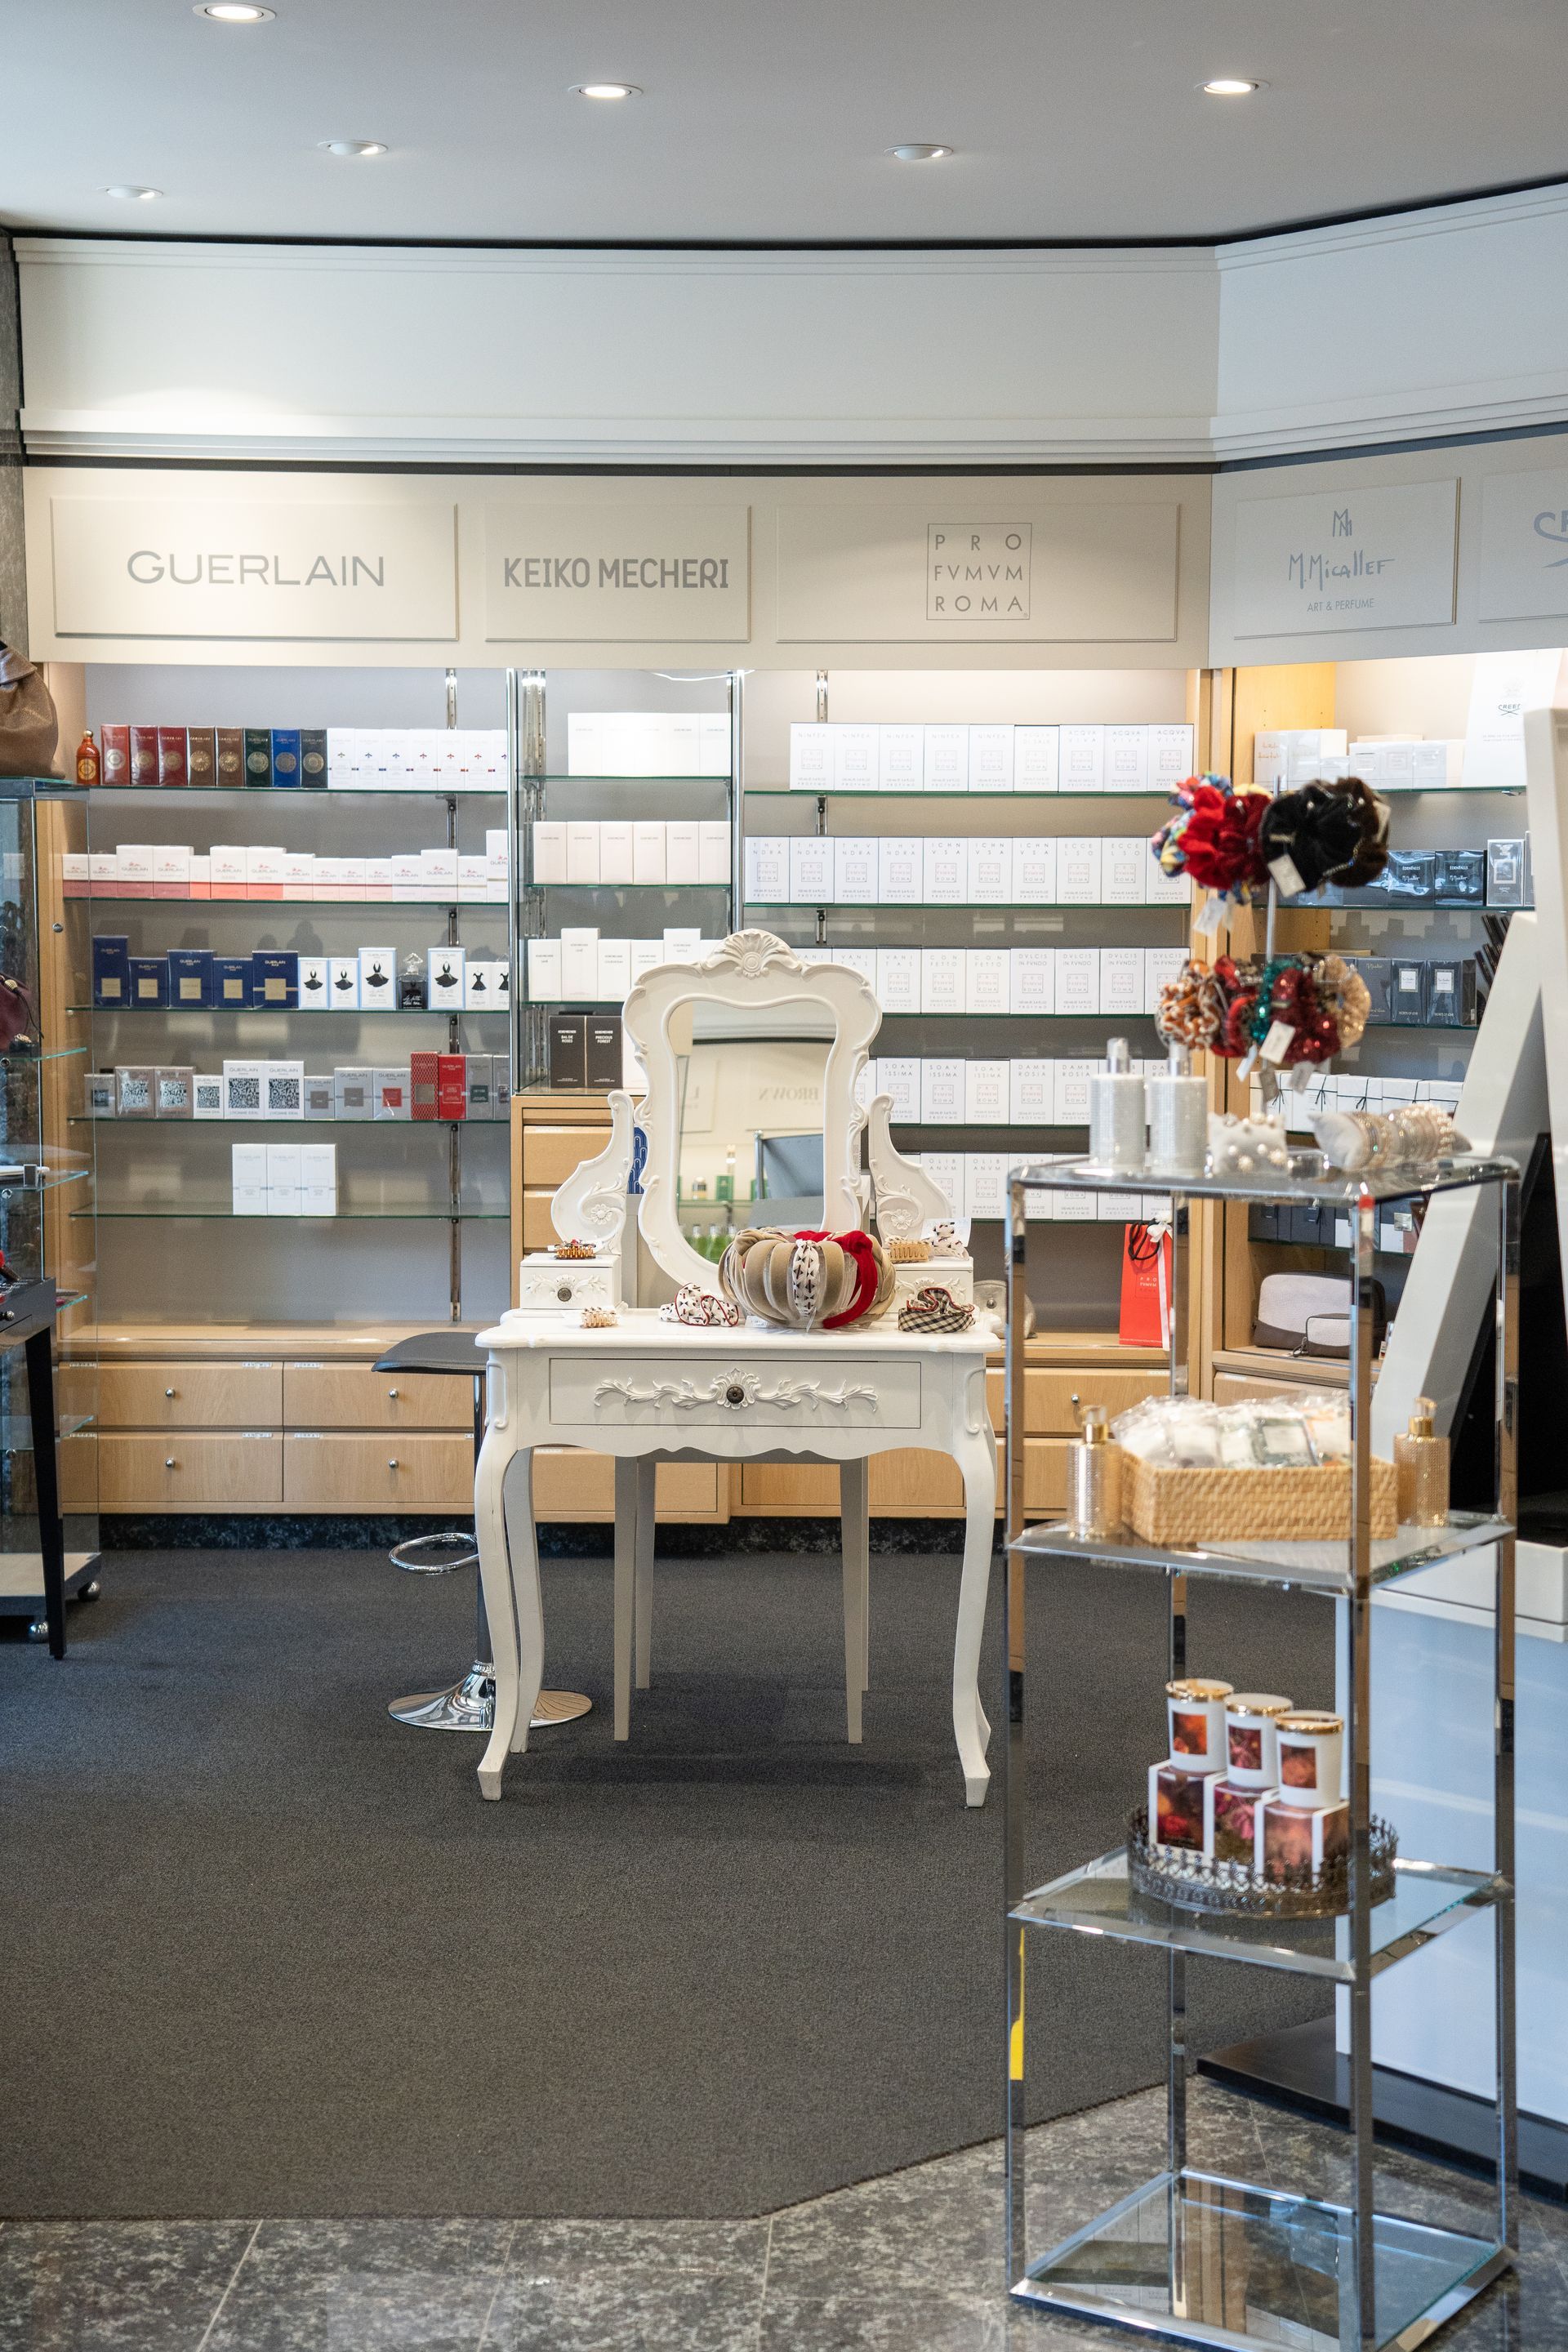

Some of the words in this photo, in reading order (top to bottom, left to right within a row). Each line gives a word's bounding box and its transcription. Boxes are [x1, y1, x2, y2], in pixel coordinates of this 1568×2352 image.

[935, 533, 1022, 551] PRO
[127, 550, 384, 586] GUERLAIN
[504, 558, 590, 588] KEIKO
[599, 558, 728, 588] MECHERI
[934, 564, 1022, 581] FVMVM
[935, 595, 1022, 612] ROMA
[1307, 603, 1323, 612] ART
[1325, 601, 1332, 611] &
[1335, 598, 1375, 610] PERFUME
